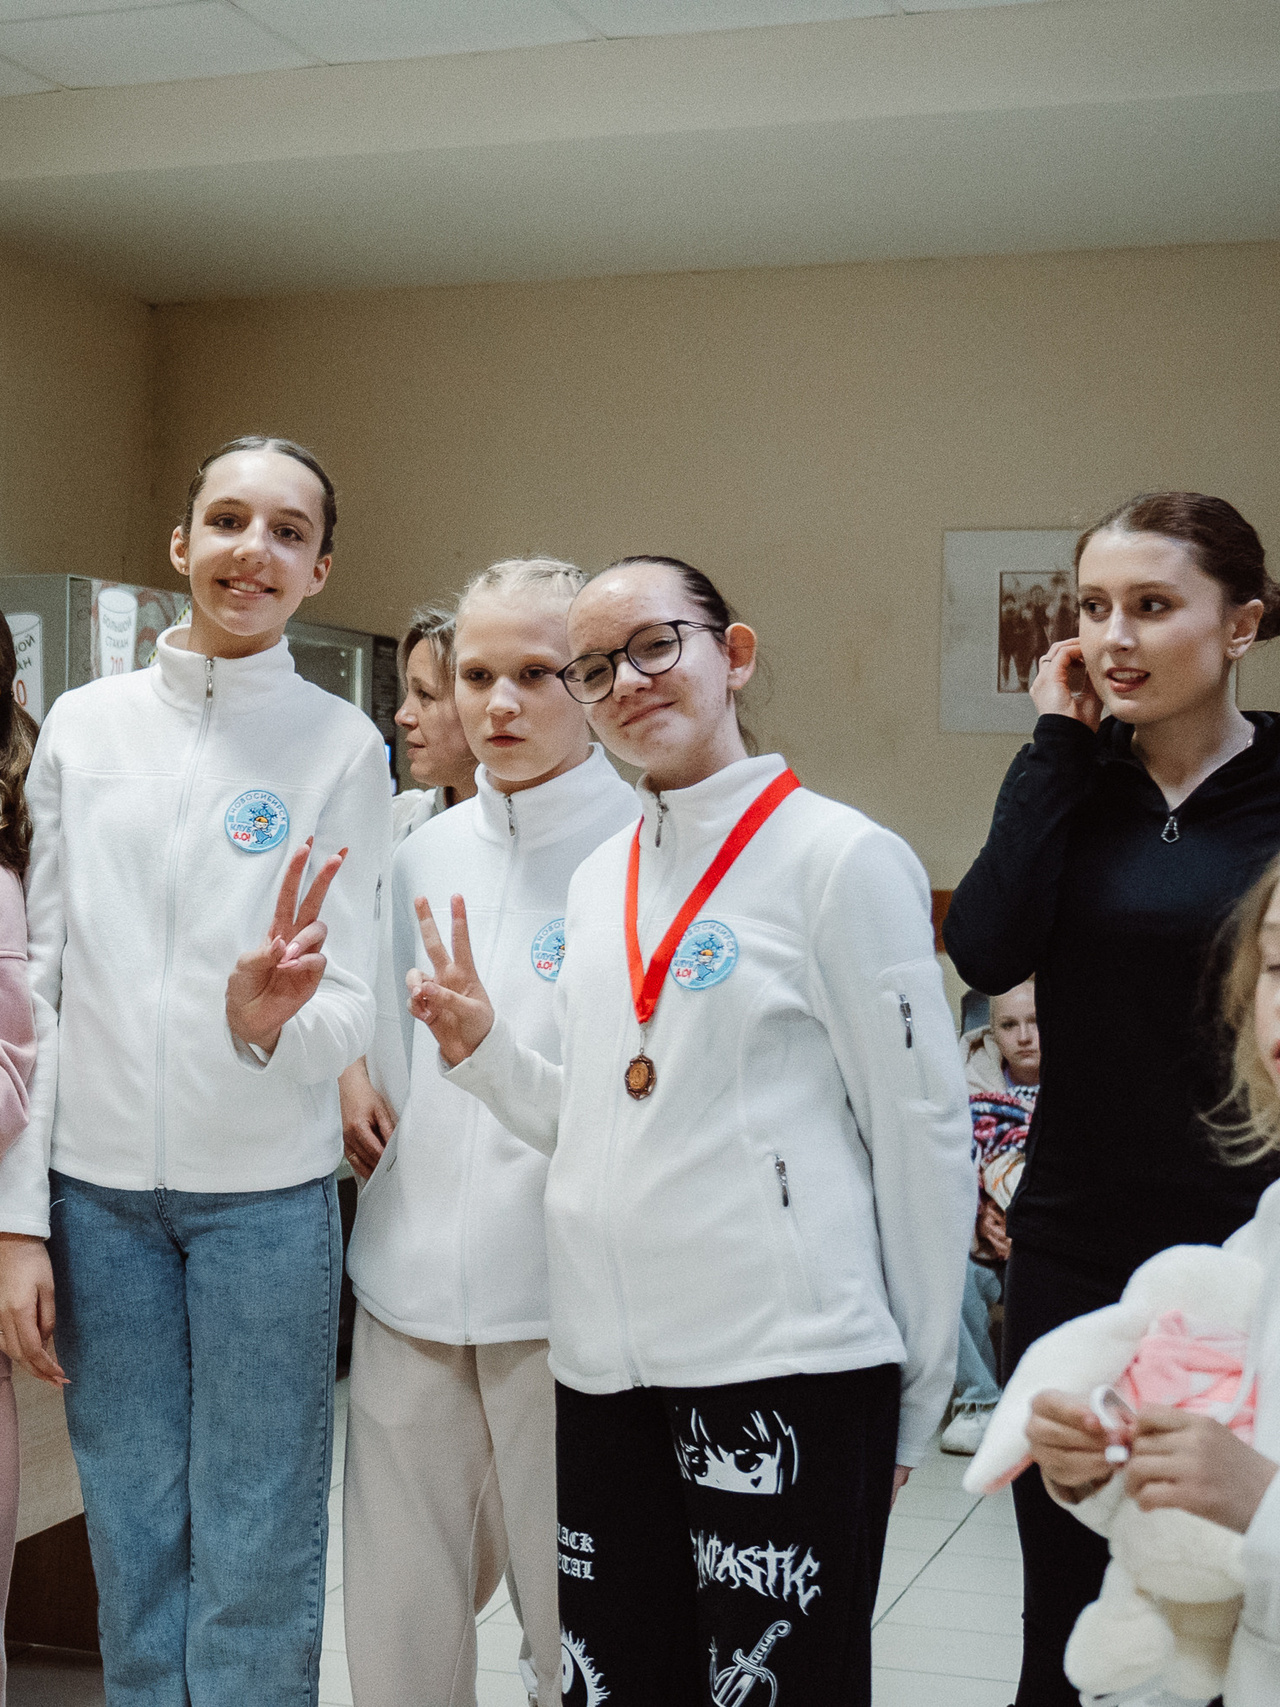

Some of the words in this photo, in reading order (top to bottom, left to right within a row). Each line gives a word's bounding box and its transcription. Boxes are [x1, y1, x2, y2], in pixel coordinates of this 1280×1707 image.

[231, 793, 287, 822] НОВОСИБИРСК
[230, 823, 252, 833] КЛУБ
[681, 923, 736, 954] ОВОСИБИРСК
[557, 1522, 595, 1553] ACK
[557, 1552, 595, 1580] TAL
